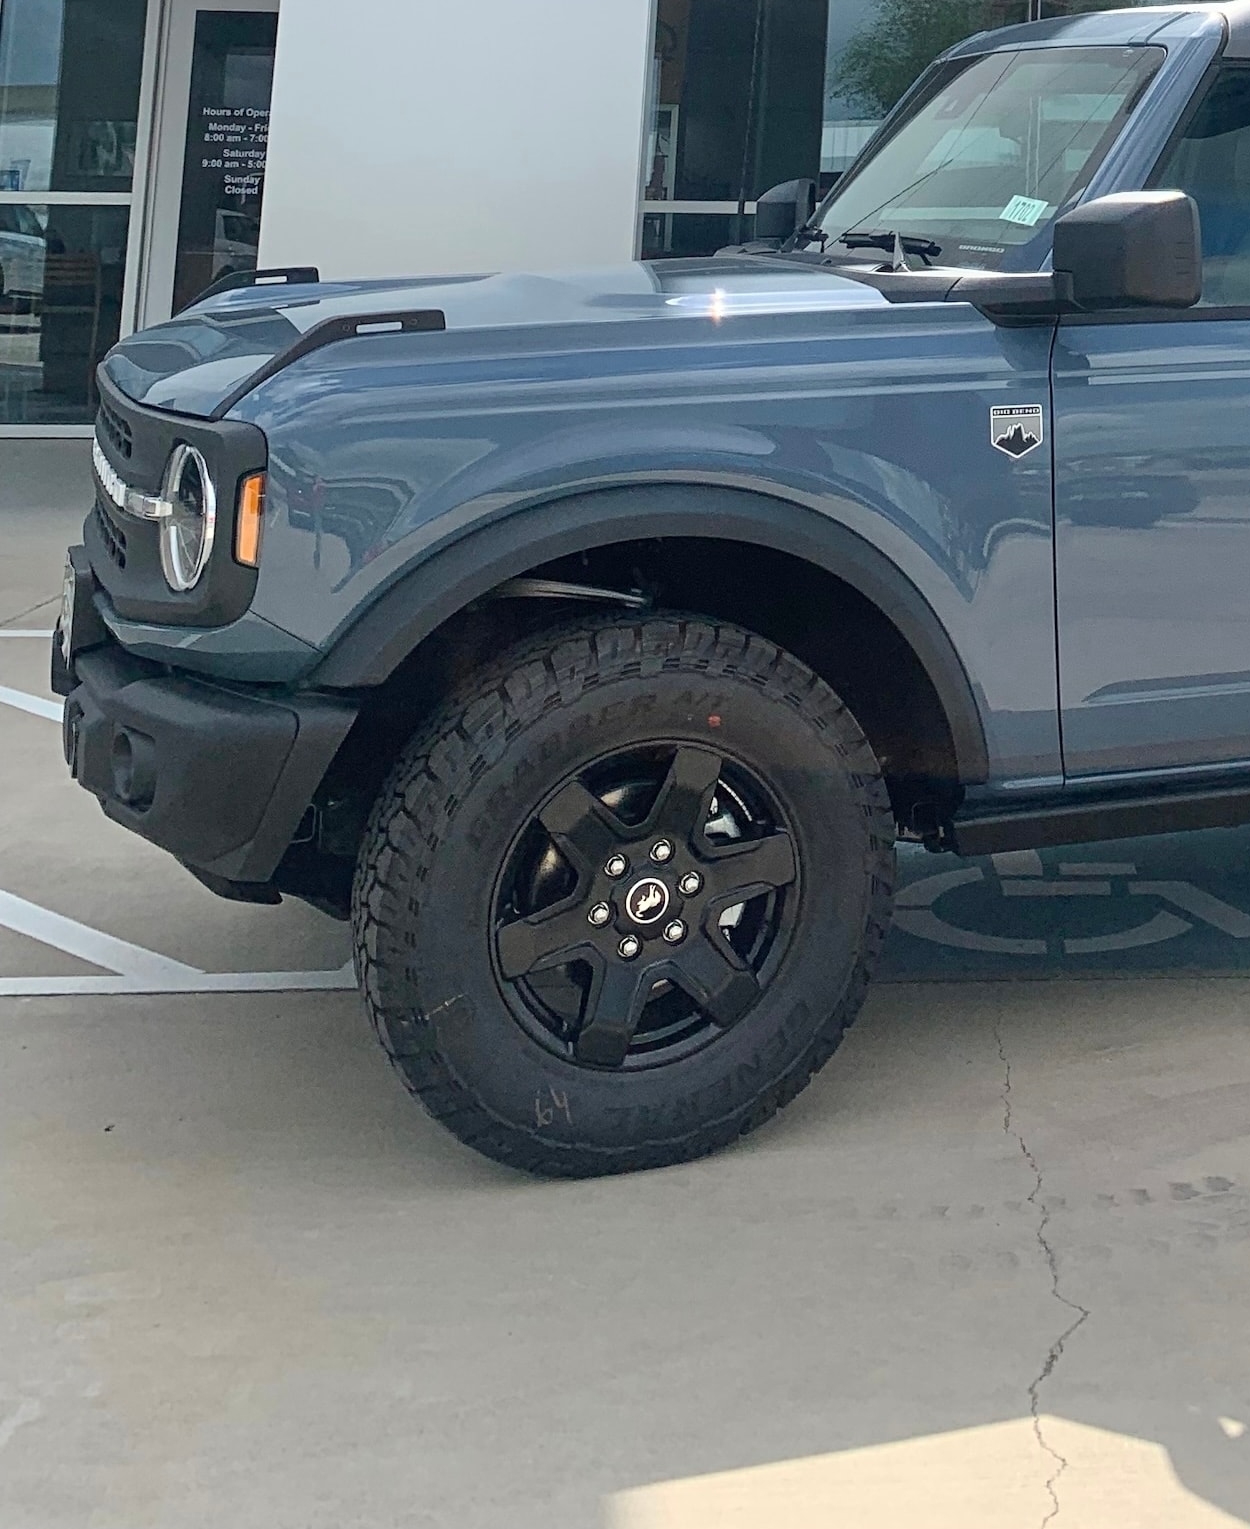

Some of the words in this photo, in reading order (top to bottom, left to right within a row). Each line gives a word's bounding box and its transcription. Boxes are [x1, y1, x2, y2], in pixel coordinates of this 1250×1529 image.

[202, 107, 232, 116] Hours
[233, 107, 245, 116] of
[246, 108, 270, 118] Oper
[208, 122, 246, 133] Monday
[204, 133, 225, 142] 8:00
[223, 148, 265, 159] Saturday
[202, 159, 223, 168] 9:00
[224, 174, 260, 185] Sunday
[224, 185, 258, 194] Closed
